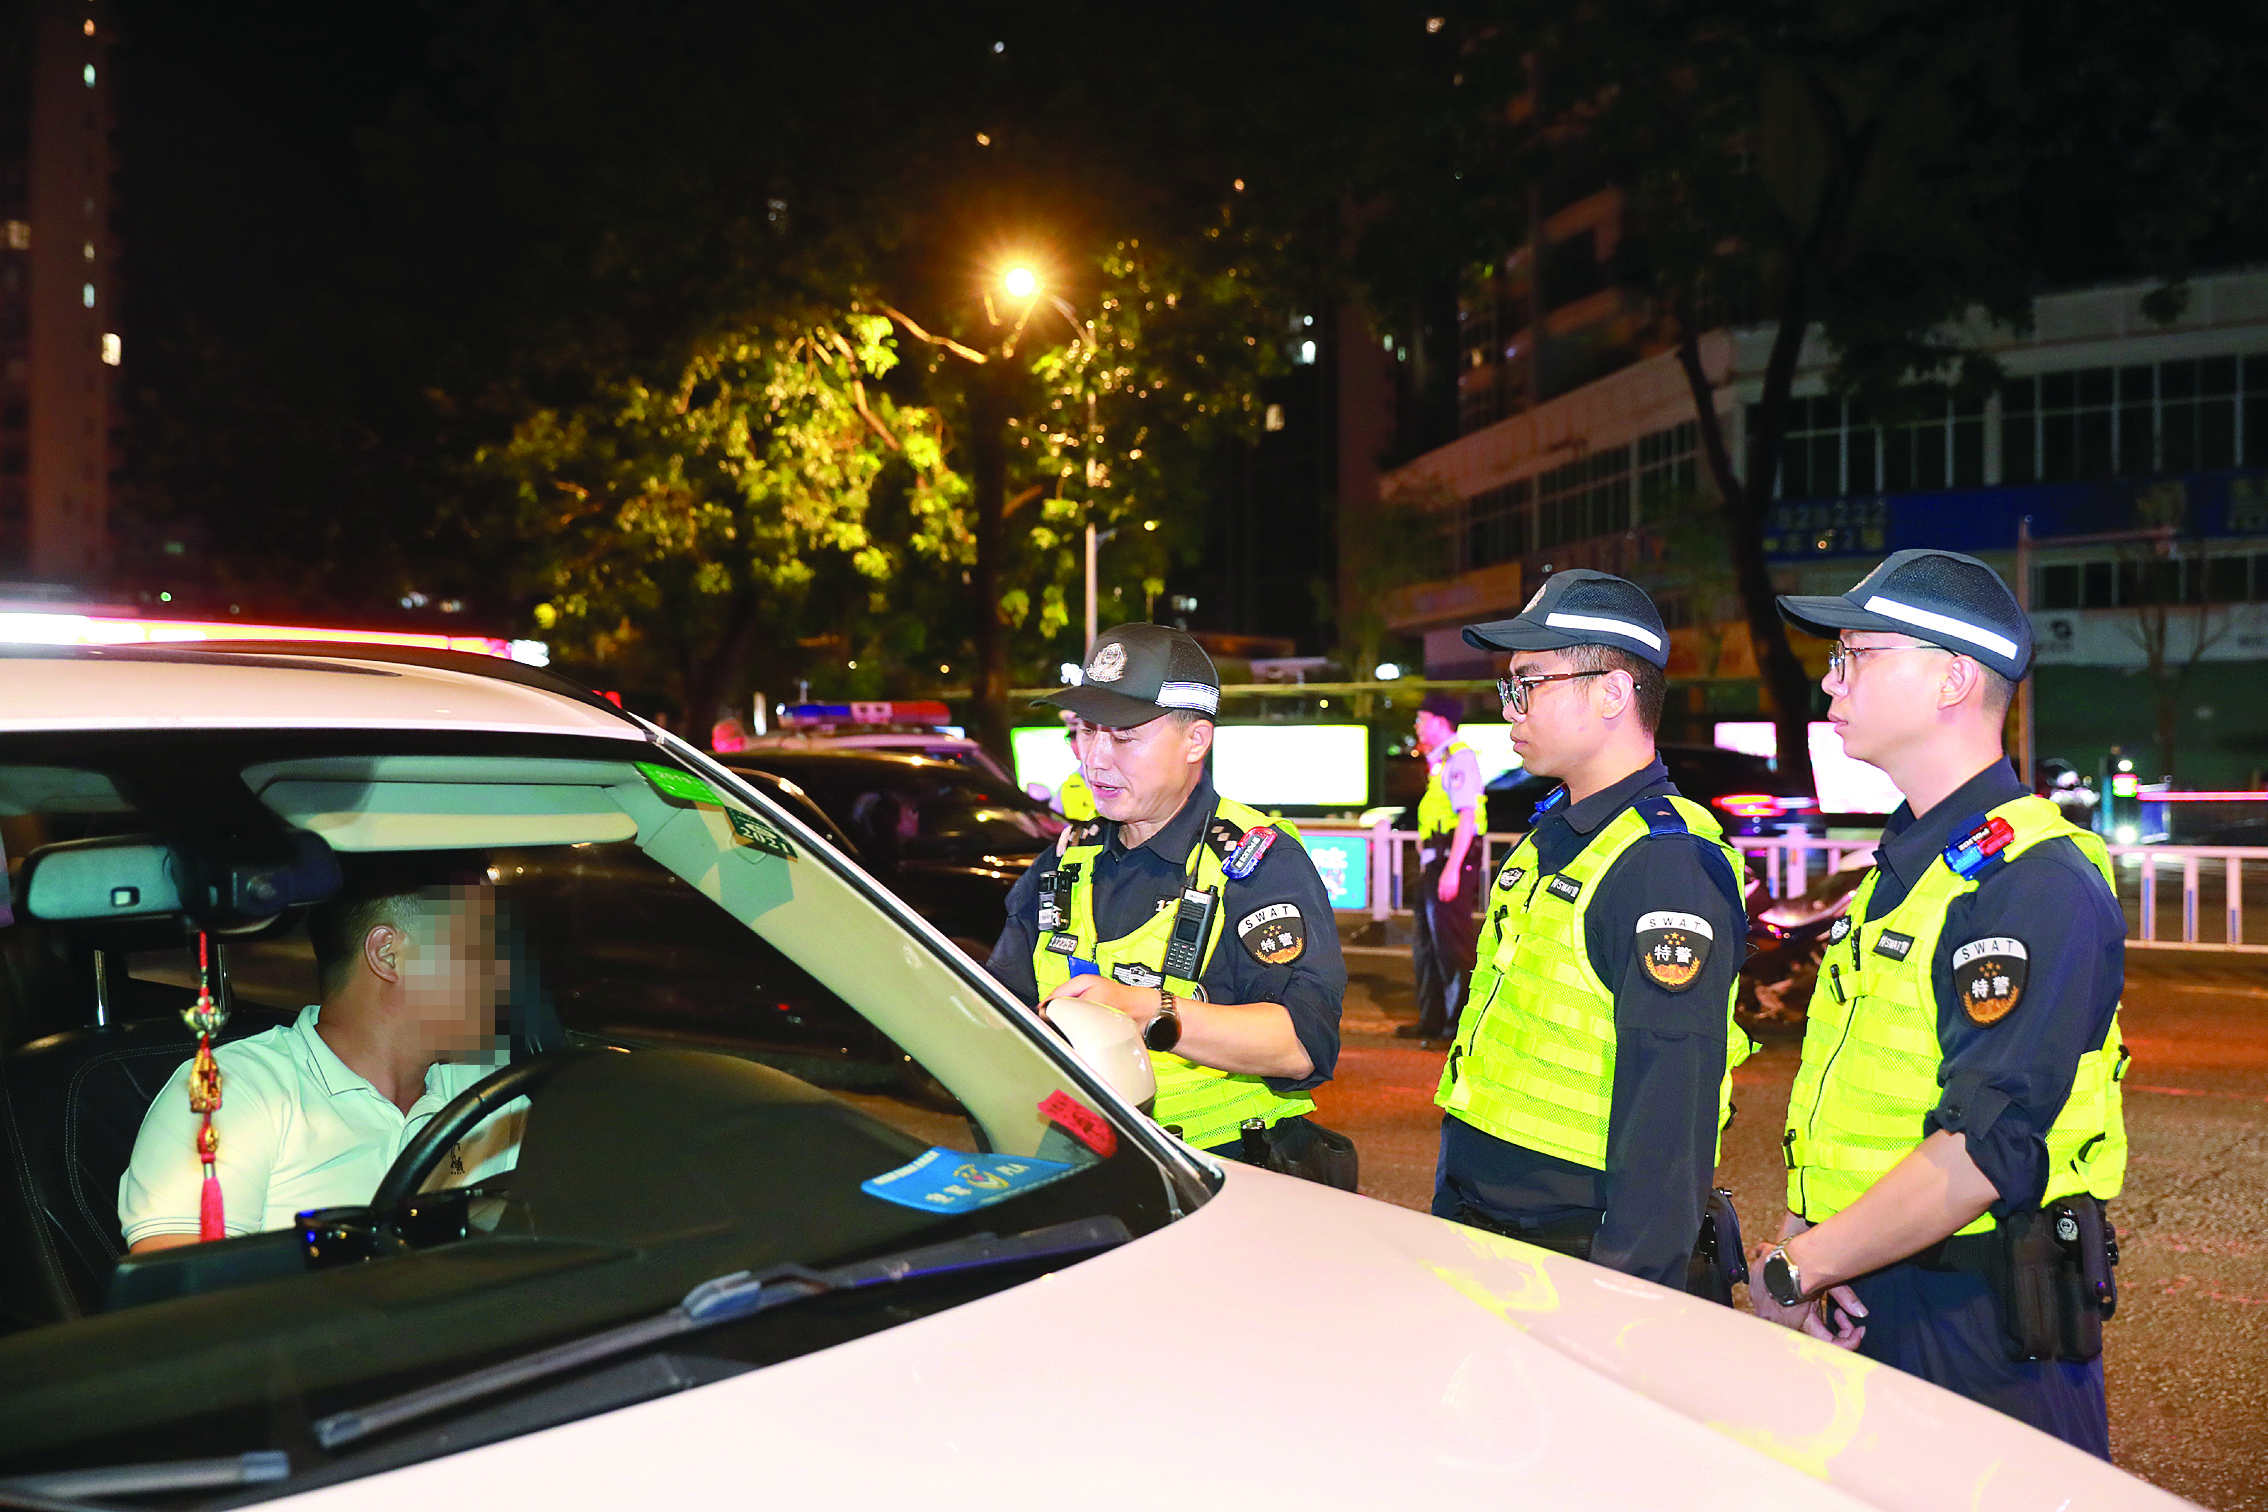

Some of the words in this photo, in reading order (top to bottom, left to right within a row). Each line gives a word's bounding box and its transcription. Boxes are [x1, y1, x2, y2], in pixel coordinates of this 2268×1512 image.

[1245, 905, 1289, 929] SWAT
[1649, 917, 1701, 931] SWAT
[1260, 932, 1294, 952] 特警
[1961, 939, 2014, 960] SWAT
[1653, 944, 1693, 964] 特警
[1971, 976, 2010, 999] 特警
